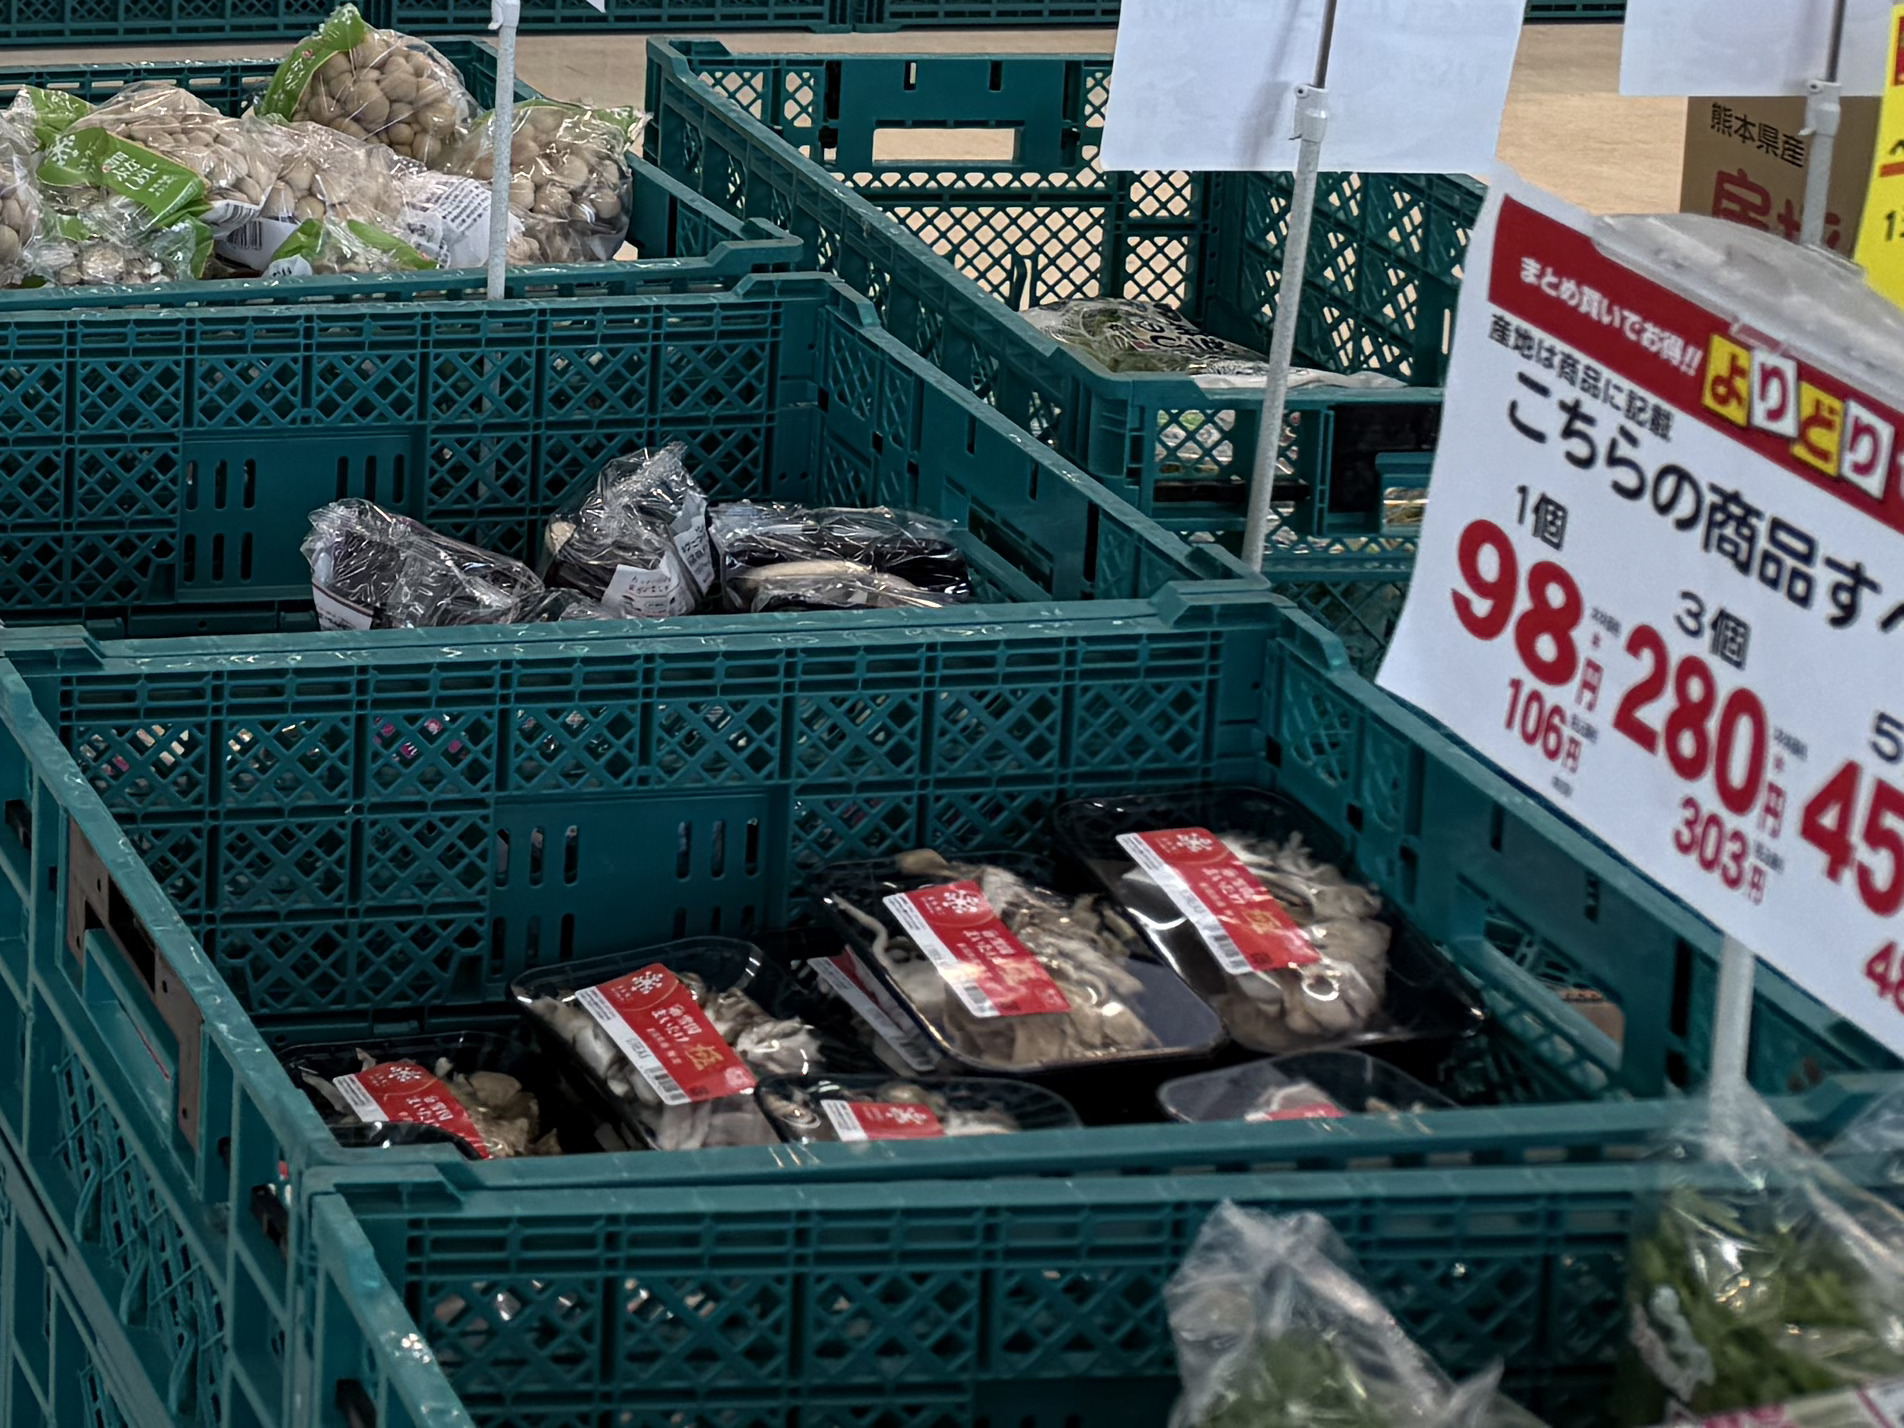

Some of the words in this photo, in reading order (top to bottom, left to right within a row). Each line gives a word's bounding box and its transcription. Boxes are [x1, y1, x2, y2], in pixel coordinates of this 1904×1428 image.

[1709, 102, 1807, 168] 熊本県産
[1701, 334, 1896, 498] よりどり
[1515, 483, 1568, 552] 1個
[1450, 518, 1586, 690] 98
[1673, 590, 1752, 672] 3個
[1502, 678, 1568, 765] 106
[1611, 624, 1770, 820] 280
[1672, 794, 1753, 891] 303
